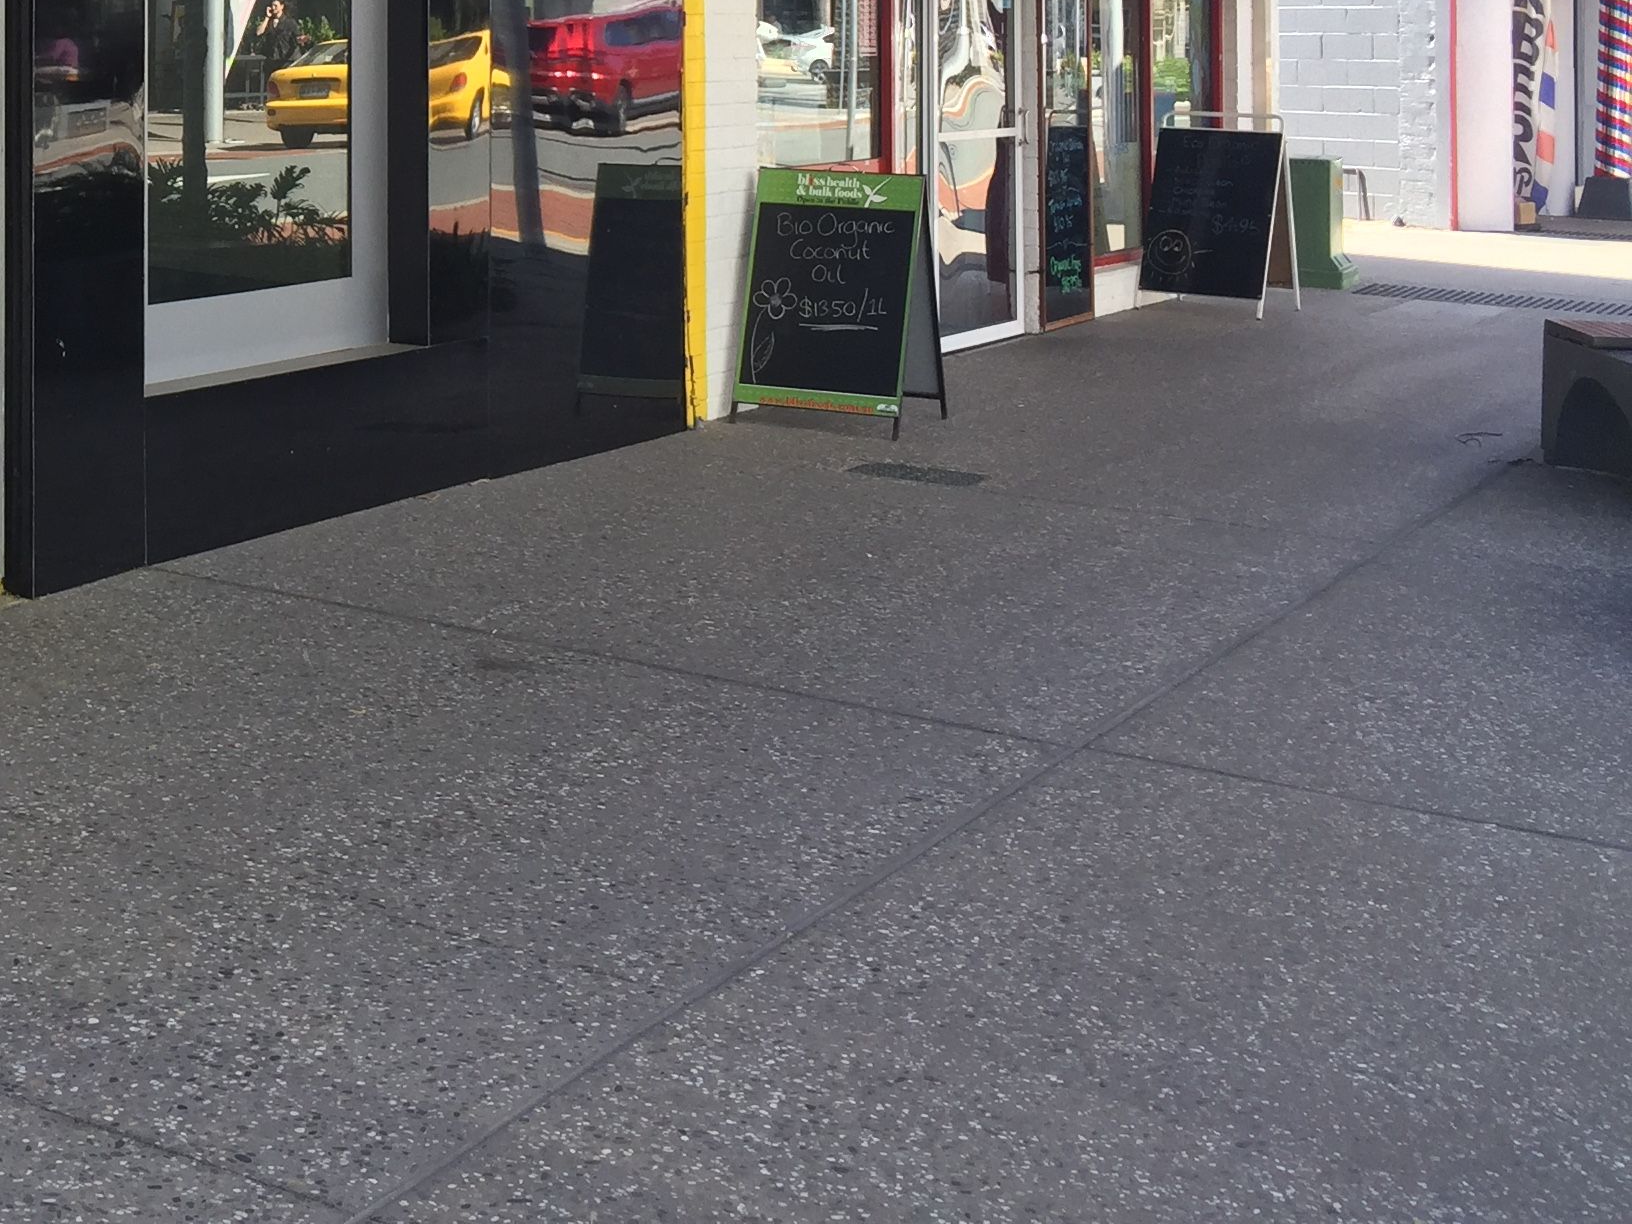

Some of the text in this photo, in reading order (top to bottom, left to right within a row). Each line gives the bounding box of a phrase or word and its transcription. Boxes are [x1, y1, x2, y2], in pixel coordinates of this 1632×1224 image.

[796, 185, 862, 198] & bulk foods
[827, 176, 860, 188] health
[777, 212, 895, 249] Bio Organic
[790, 238, 870, 260] Coconut
[811, 264, 846, 284] Oil
